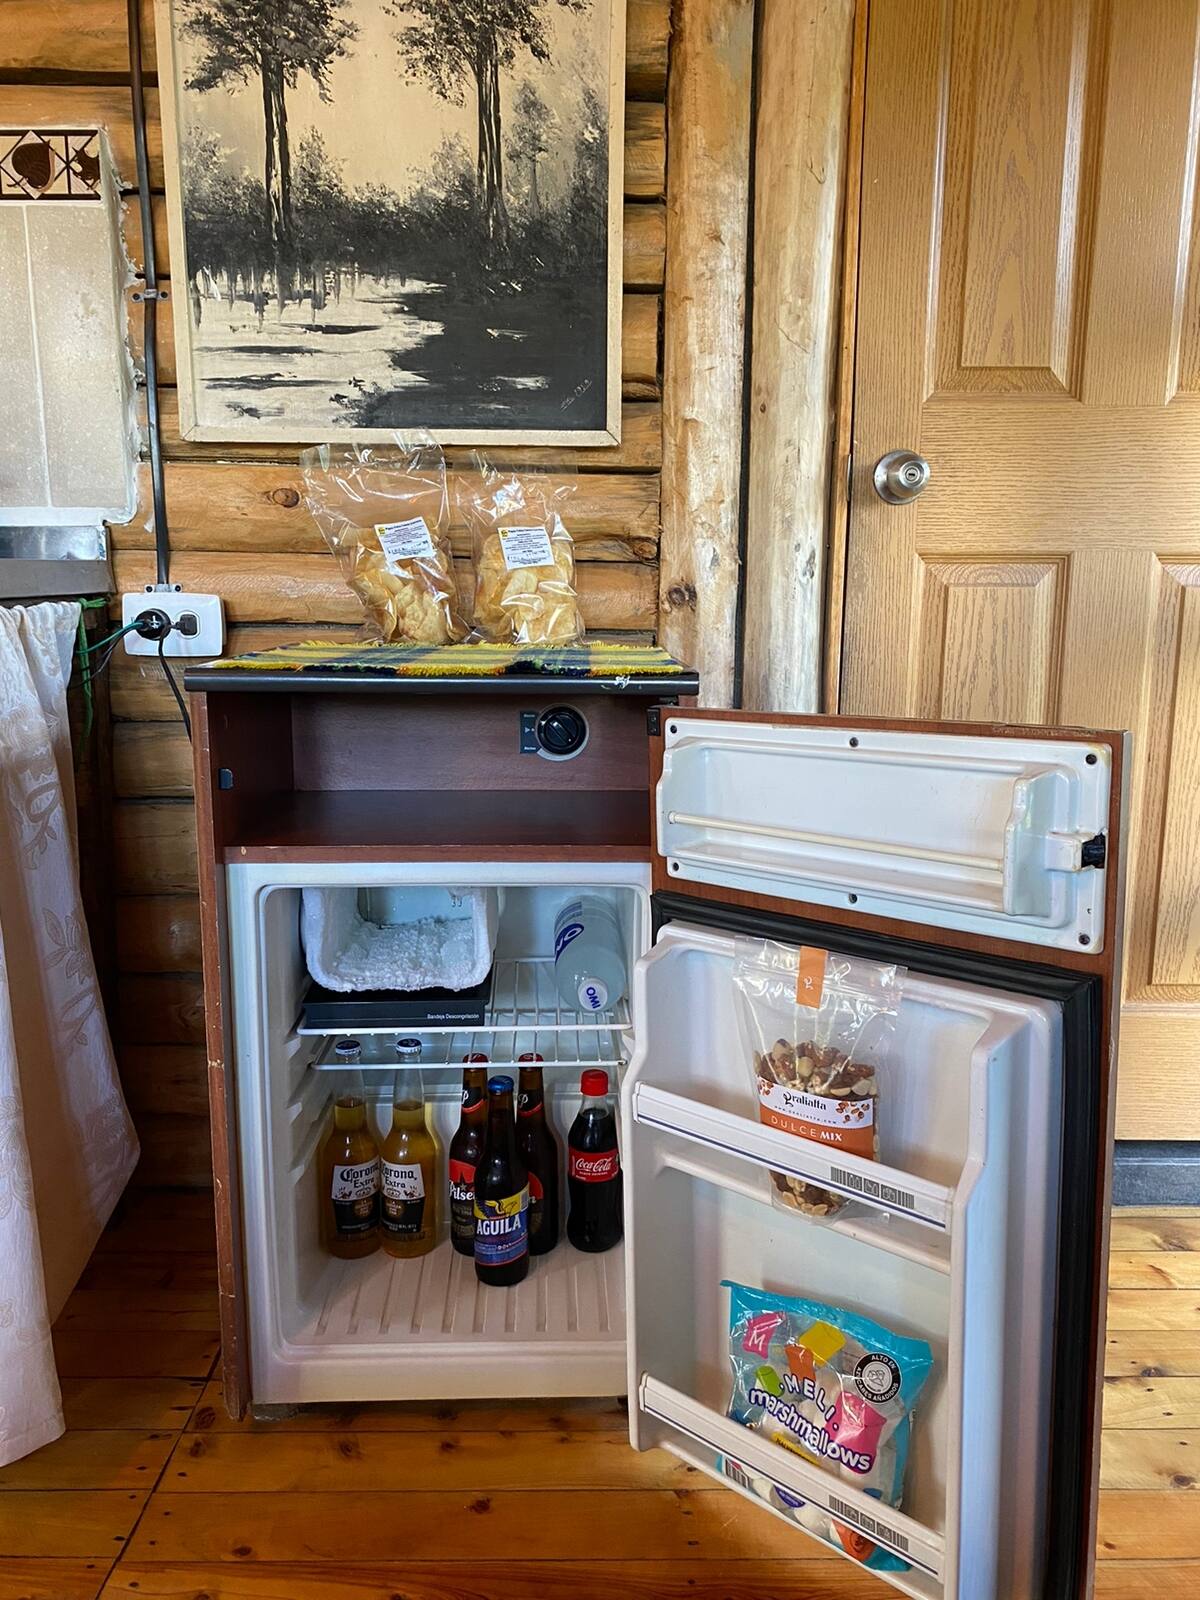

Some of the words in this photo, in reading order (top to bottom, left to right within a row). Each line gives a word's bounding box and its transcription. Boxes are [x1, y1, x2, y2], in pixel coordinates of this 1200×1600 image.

[586, 987, 601, 1009] OMI
[771, 1115, 817, 1138] DULCE
[820, 1130, 842, 1142] MIX
[576, 1157, 613, 1172] Coca-Cola
[385, 1176, 406, 1188] Extra
[476, 1213, 521, 1235] AGUILA
[871, 1354, 889, 1363] ALTO
[888, 1360, 897, 1369] EN
[749, 1388, 873, 1473] marshmallows
